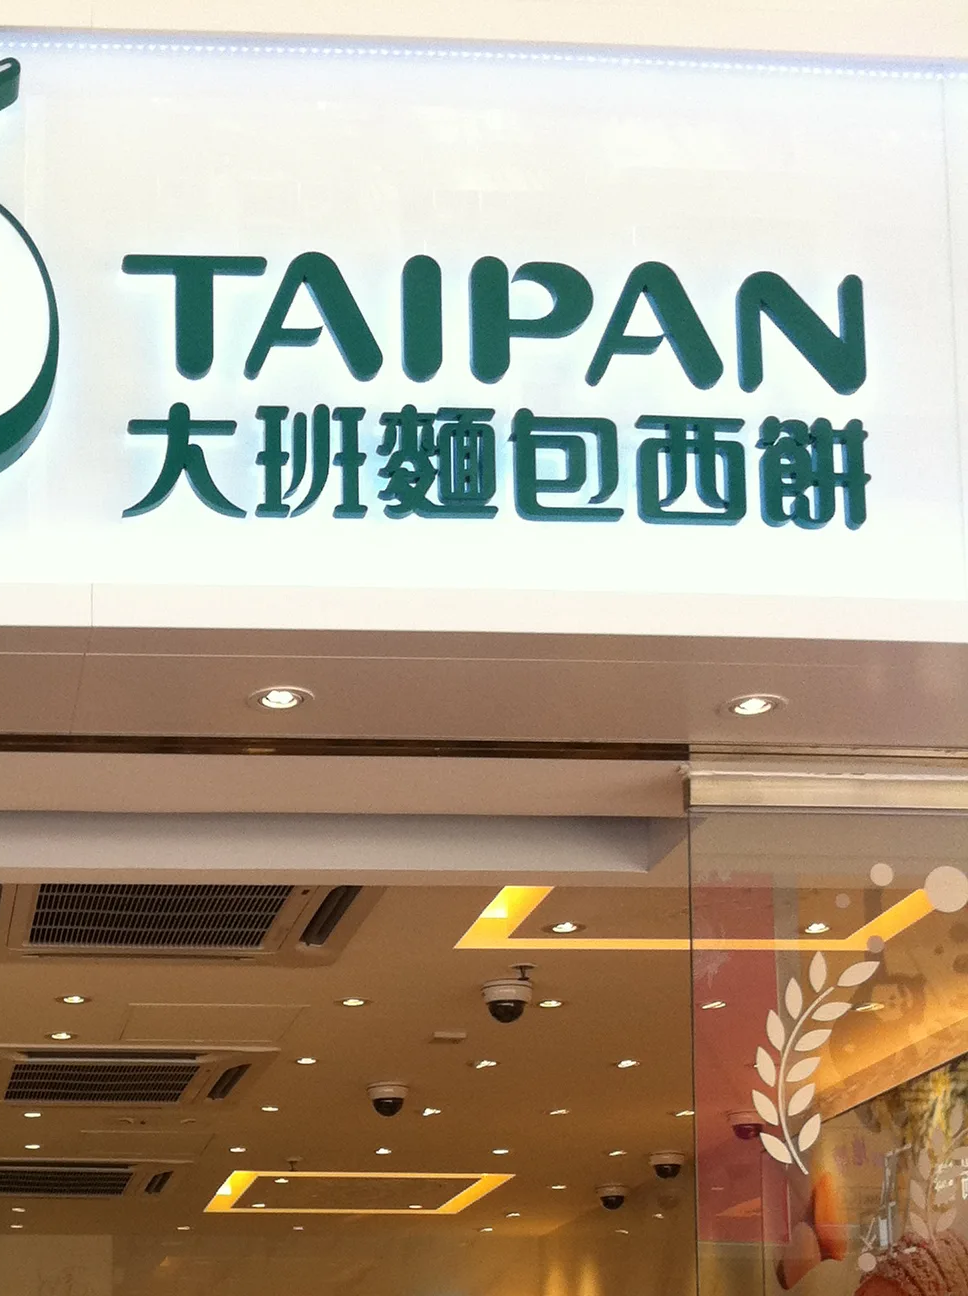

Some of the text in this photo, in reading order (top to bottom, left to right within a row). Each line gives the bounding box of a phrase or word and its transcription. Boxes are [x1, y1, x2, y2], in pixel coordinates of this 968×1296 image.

[121, 251, 867, 396] TAIPAN
[121, 402, 870, 530] 大班麵包西餅
